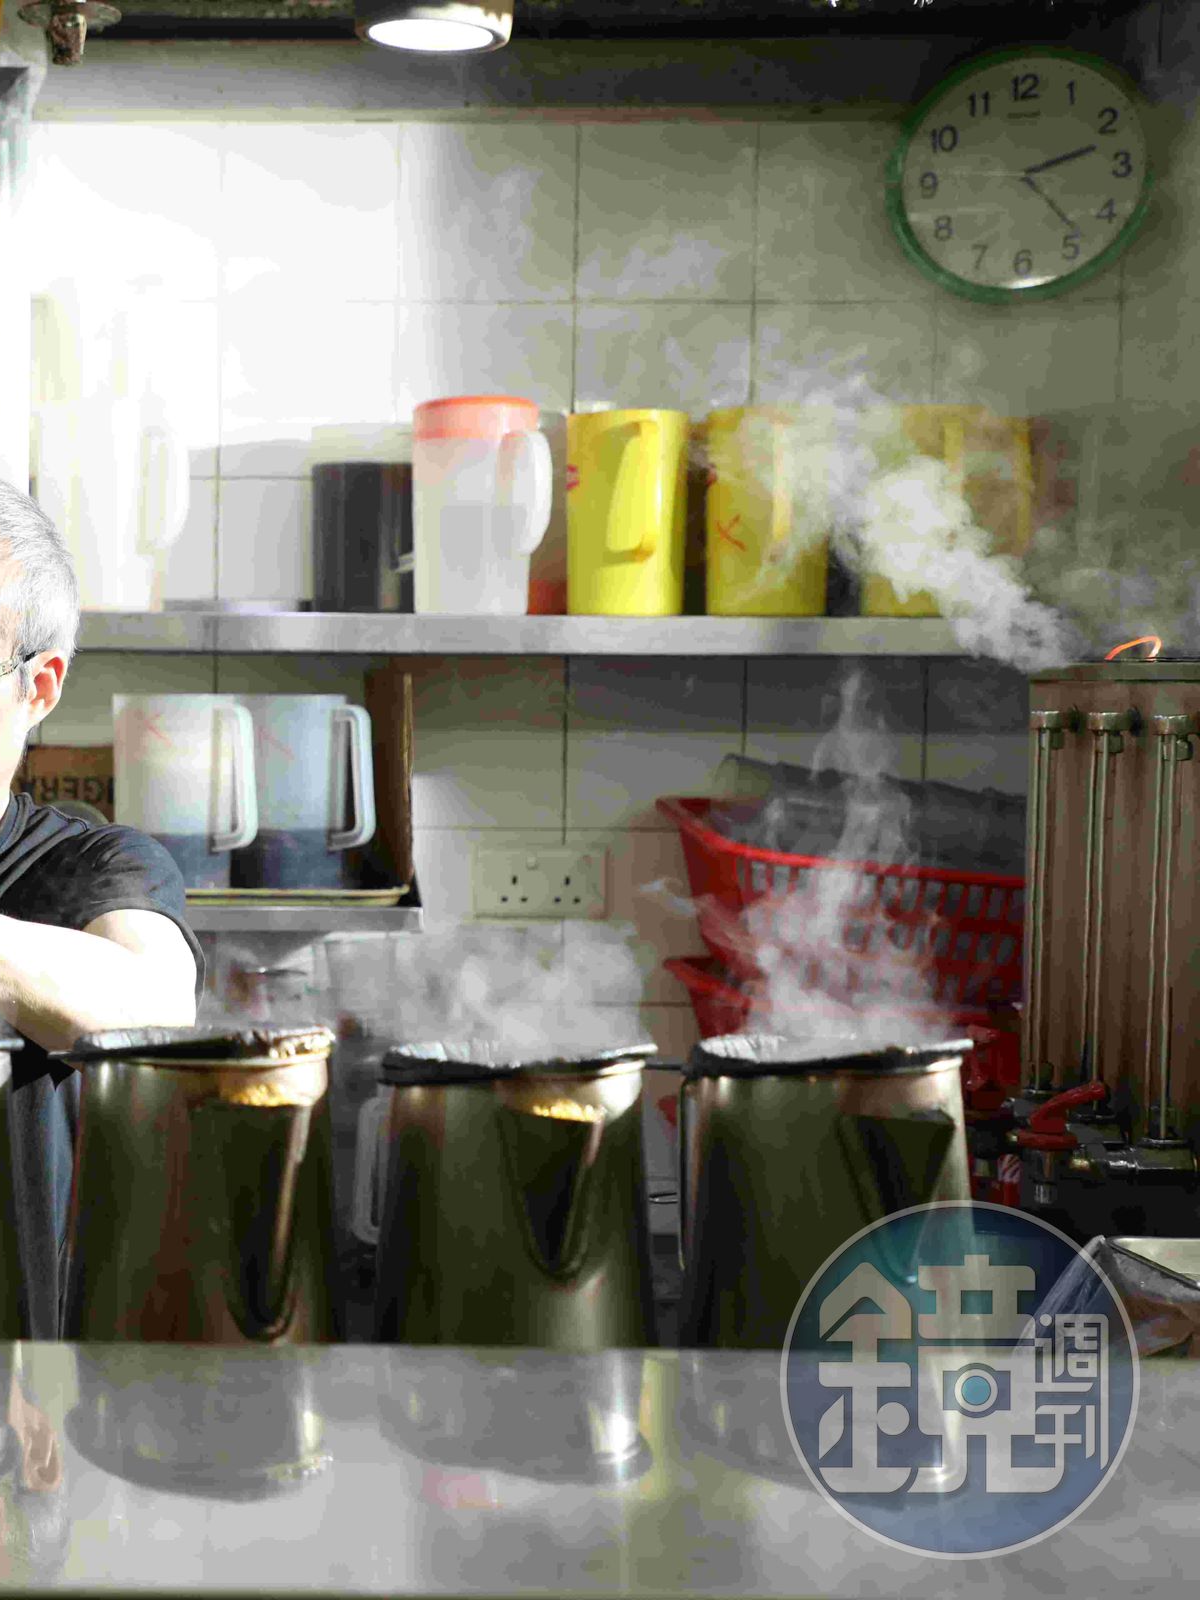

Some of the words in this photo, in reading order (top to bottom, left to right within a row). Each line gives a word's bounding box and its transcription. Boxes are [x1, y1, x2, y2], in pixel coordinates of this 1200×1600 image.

[1010, 73, 1040, 102] 12
[1065, 80, 1076, 105] 1
[968, 91, 990, 117] 11
[1097, 107, 1119, 135] 2
[930, 124, 959, 153] 10
[1111, 151, 1133, 179] 3
[919, 172, 939, 200] 9
[1096, 198, 1118, 224] 4
[934, 215, 954, 242] 8
[971, 244, 989, 271] 7
[1062, 229, 1081, 261] 5
[1013, 248, 1033, 277] 6
